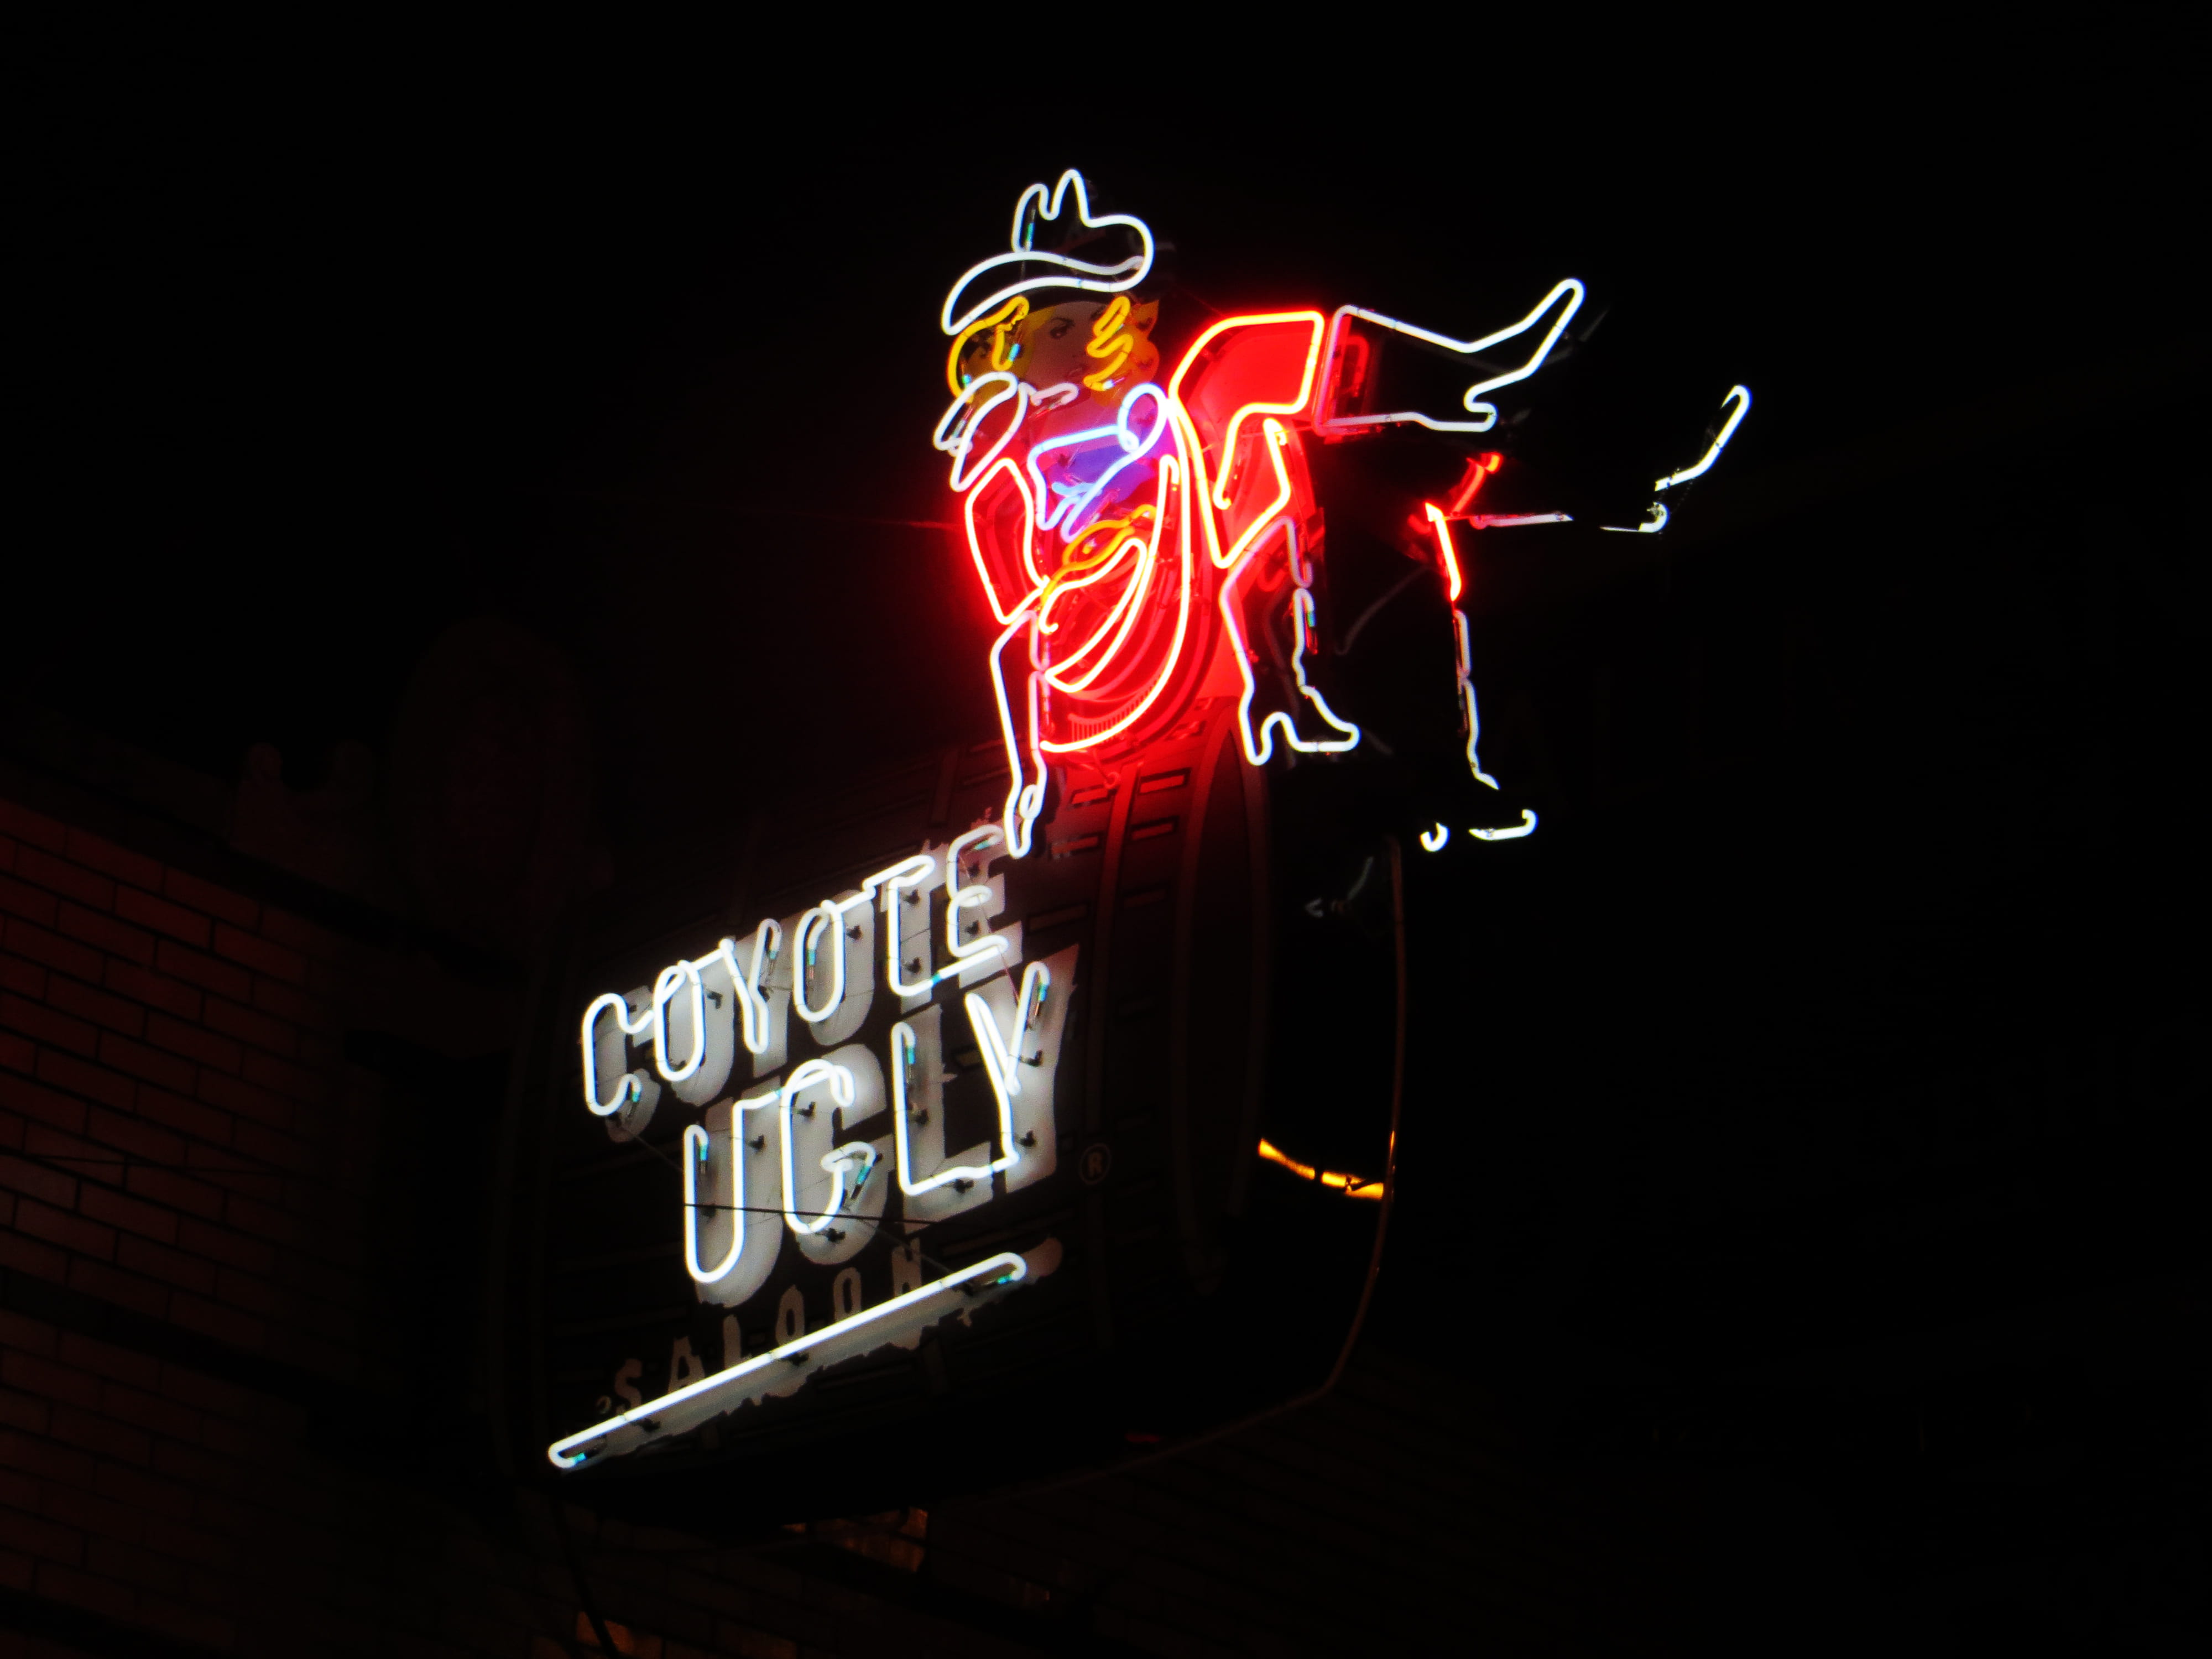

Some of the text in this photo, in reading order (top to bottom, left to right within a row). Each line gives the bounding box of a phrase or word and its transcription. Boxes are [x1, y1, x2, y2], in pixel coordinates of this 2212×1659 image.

[582, 813, 1022, 1144] COYOTE
[684, 943, 1080, 1308] UGLY
[613, 1237, 922, 1419] SALOON
